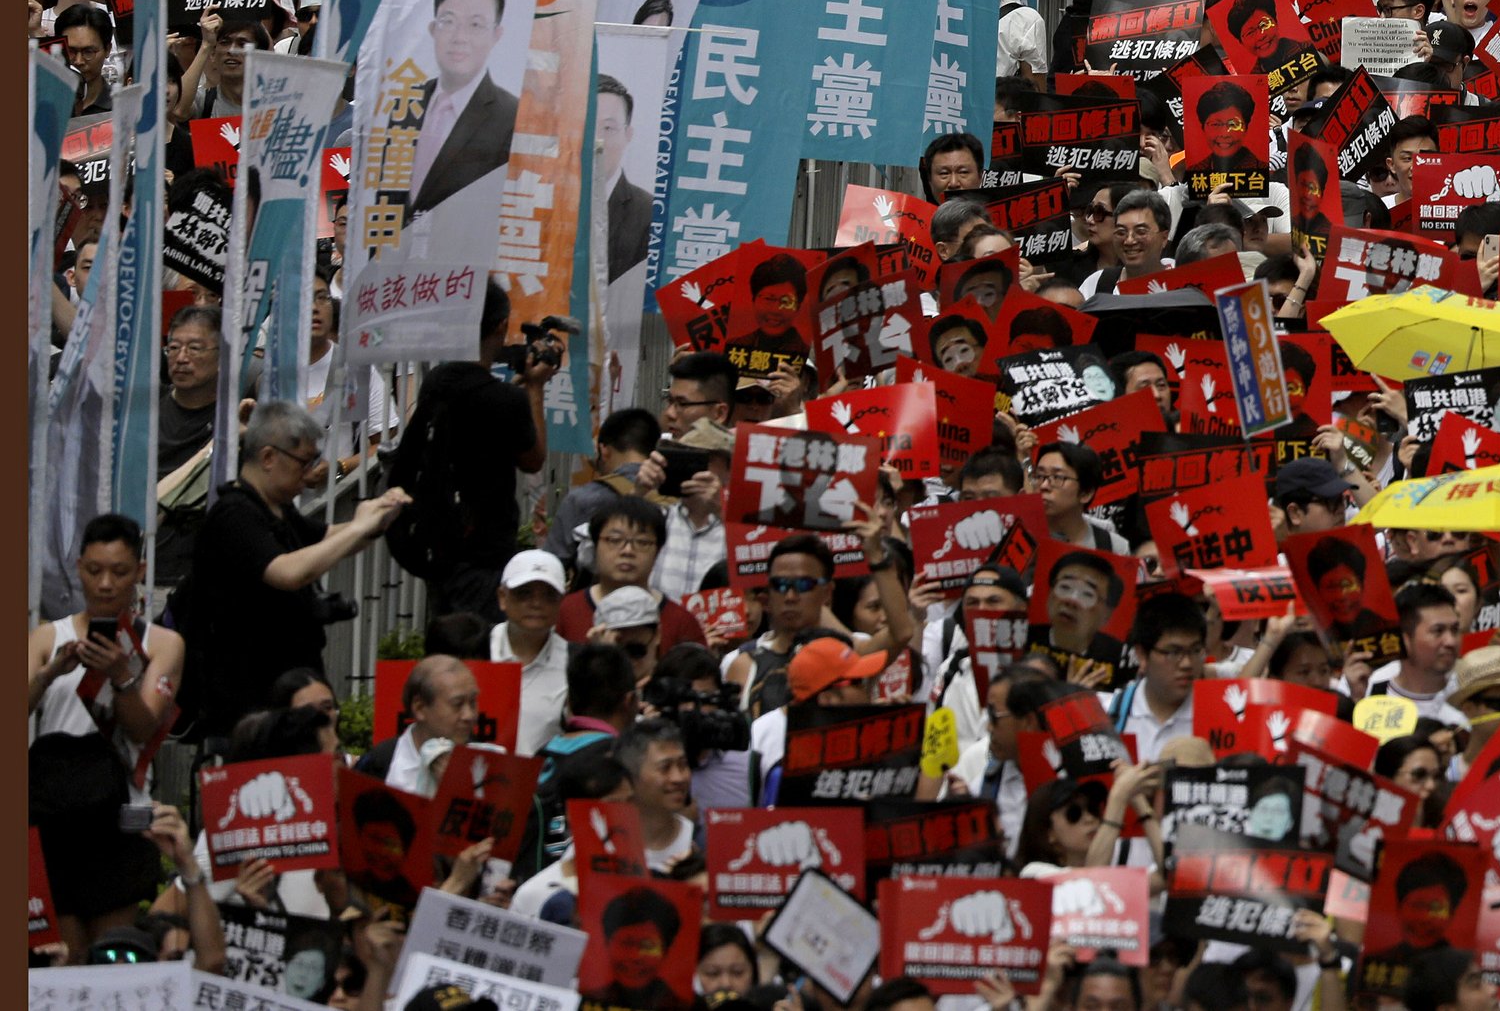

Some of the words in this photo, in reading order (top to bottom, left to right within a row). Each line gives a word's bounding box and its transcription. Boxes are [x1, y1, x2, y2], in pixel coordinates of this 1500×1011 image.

[1024, 105, 1140, 144] 撤回修訂
[1336, 105, 1395, 177] 逃犯條例
[655, 65, 679, 226] DEMOCRATIC
[673, 24, 760, 274] 民主黨
[1046, 146, 1136, 169] 逃犯條例
[1191, 171, 1265, 192] 林鄭下台
[645, 230, 660, 291] PARTY
[1338, 237, 1443, 282] 賣港林鄭
[357, 266, 475, 316] 做該做的
[819, 280, 907, 334] 賣港林鄭
[727, 345, 806, 375] 林鄭下台
[819, 316, 913, 376] 下台
[1007, 360, 1074, 384] 媚共禍港
[1020, 378, 1089, 412] 林鄭下台
[745, 434, 867, 475] 賣港林鄭
[743, 466, 858, 526] 下台
[1172, 527, 1253, 568] 反送中
[811, 767, 919, 799] 逃犯條例
[298, 841, 329, 853] CHINA
